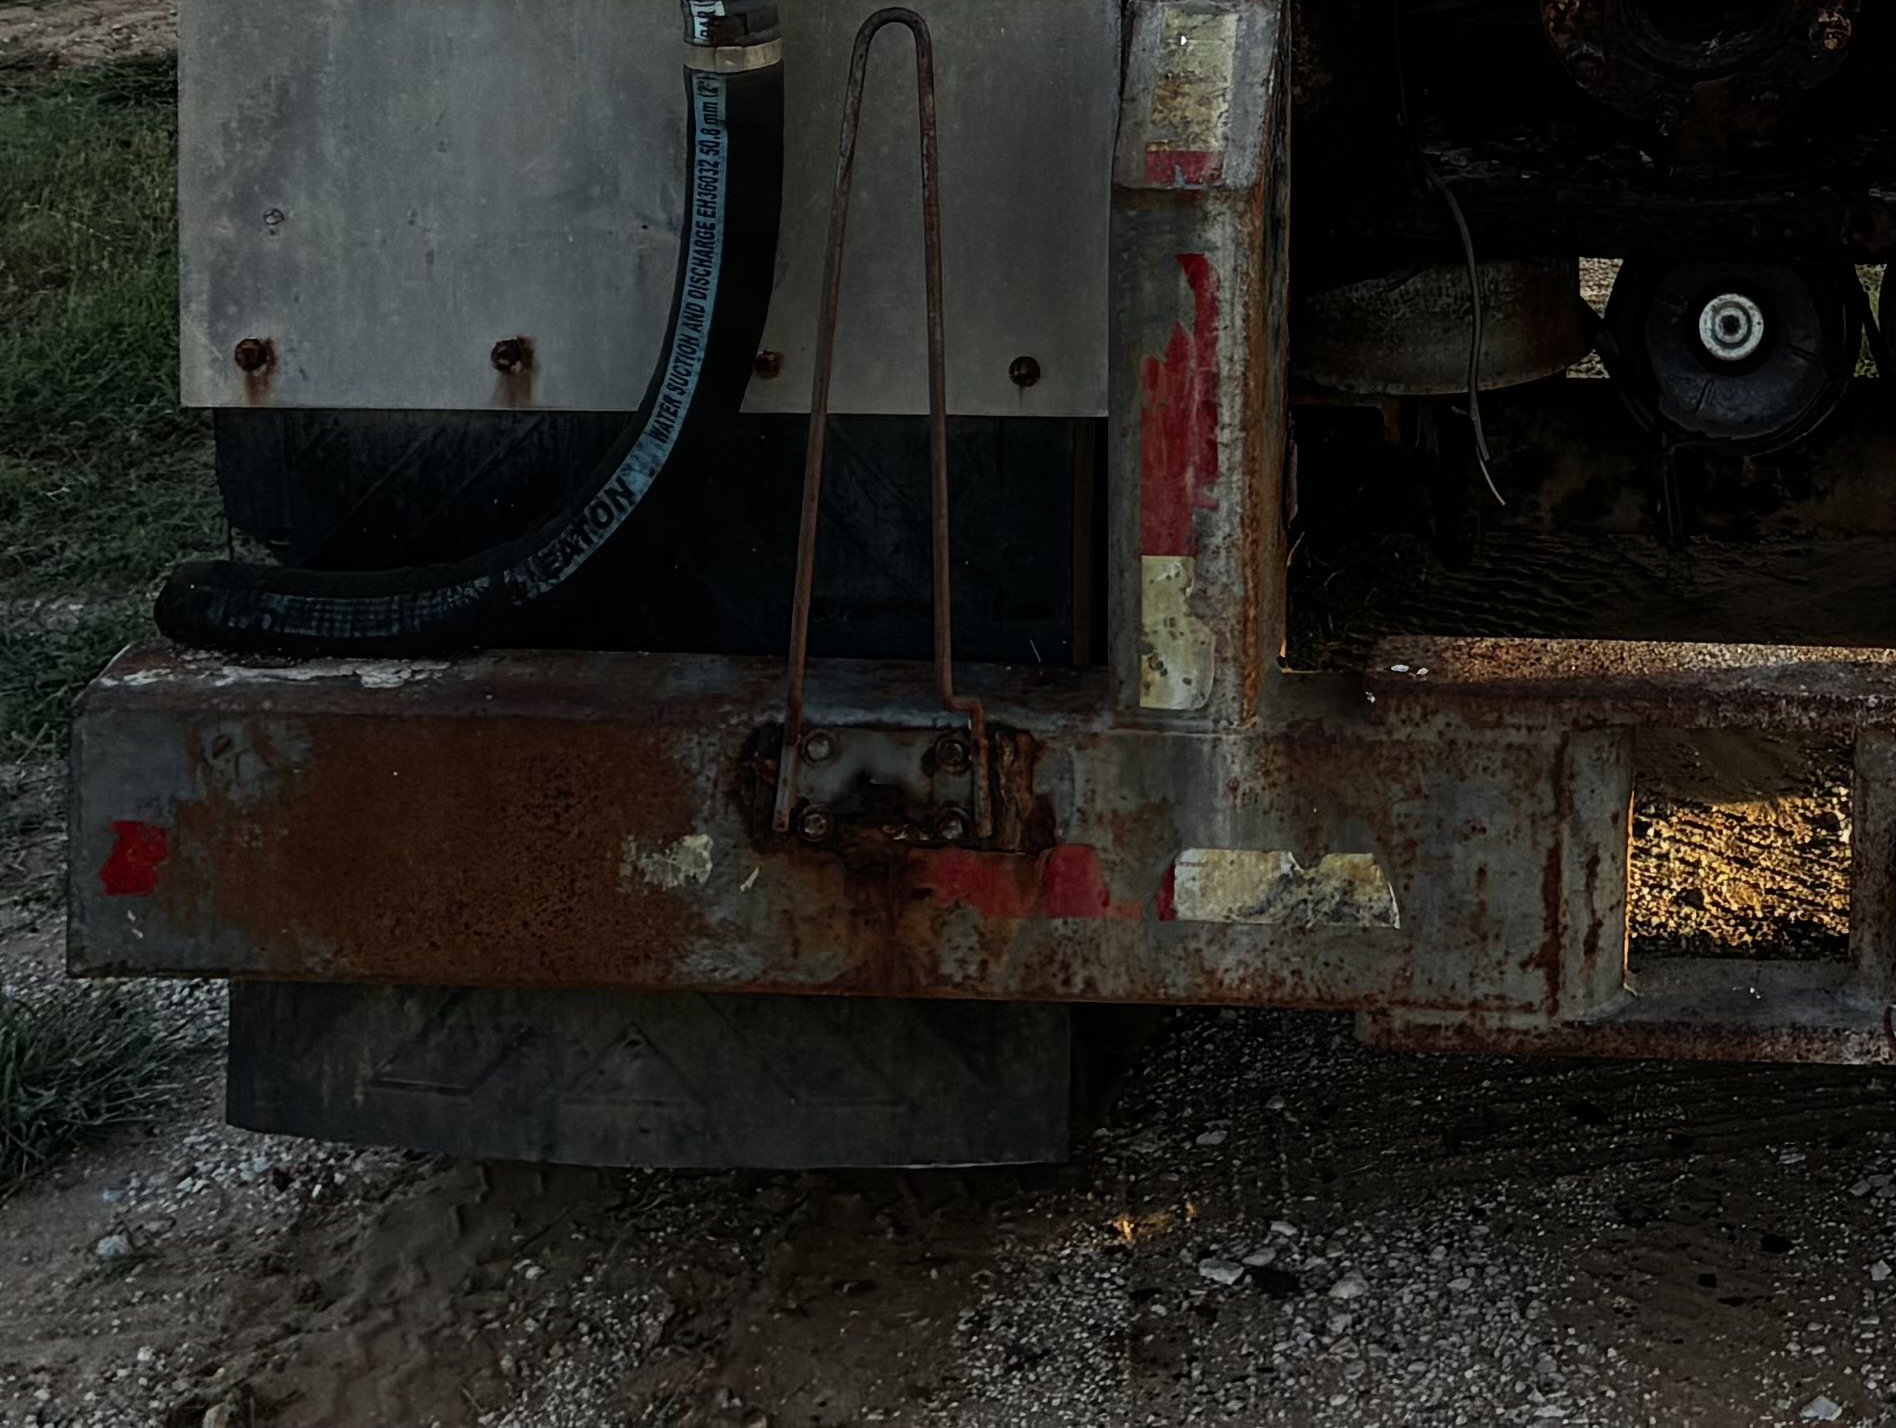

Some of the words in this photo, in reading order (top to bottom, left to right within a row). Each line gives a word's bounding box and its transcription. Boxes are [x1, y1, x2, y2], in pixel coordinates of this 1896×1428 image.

[702, 100, 719, 126] mm
[698, 128, 721, 157] 50.8
[696, 159, 721, 219] EH36032
[688, 221, 717, 301] DISCHARGE
[681, 302, 706, 334] AND
[666, 334, 701, 396] SUCTION
[651, 398, 683, 444] WATER
